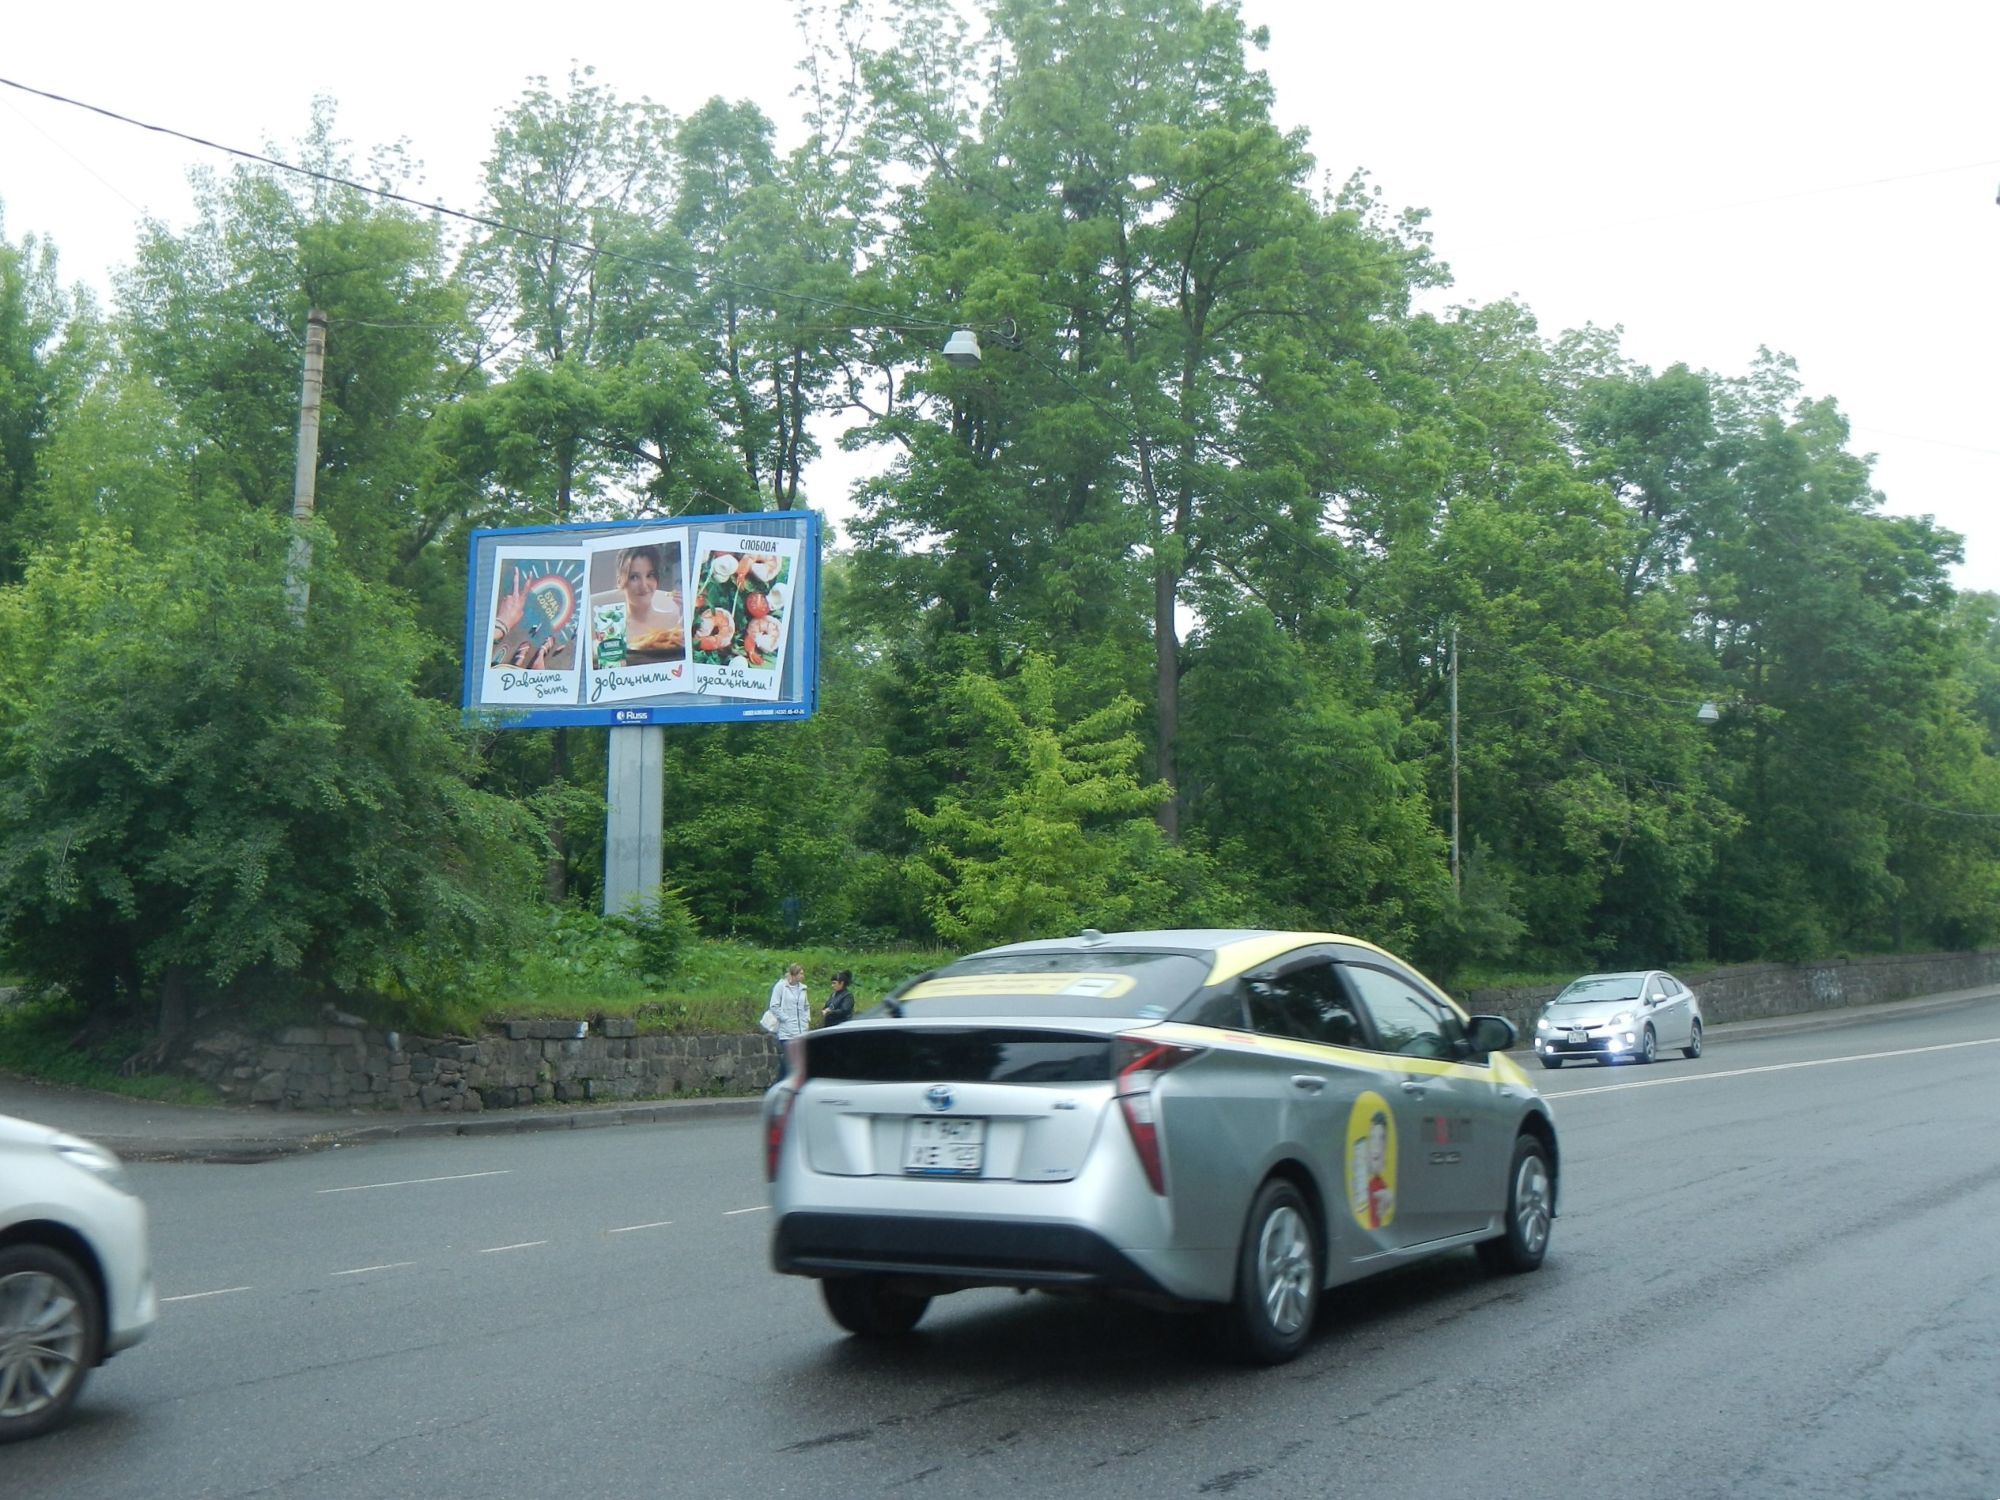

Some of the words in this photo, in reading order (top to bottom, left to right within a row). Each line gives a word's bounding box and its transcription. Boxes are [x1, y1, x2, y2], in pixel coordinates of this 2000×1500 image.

[740, 539, 777, 552] СЛОБОДА
[718, 667, 727, 676] а
[730, 669, 744, 678] не
[501, 671, 563, 691] Давайте
[535, 684, 568, 698] быть
